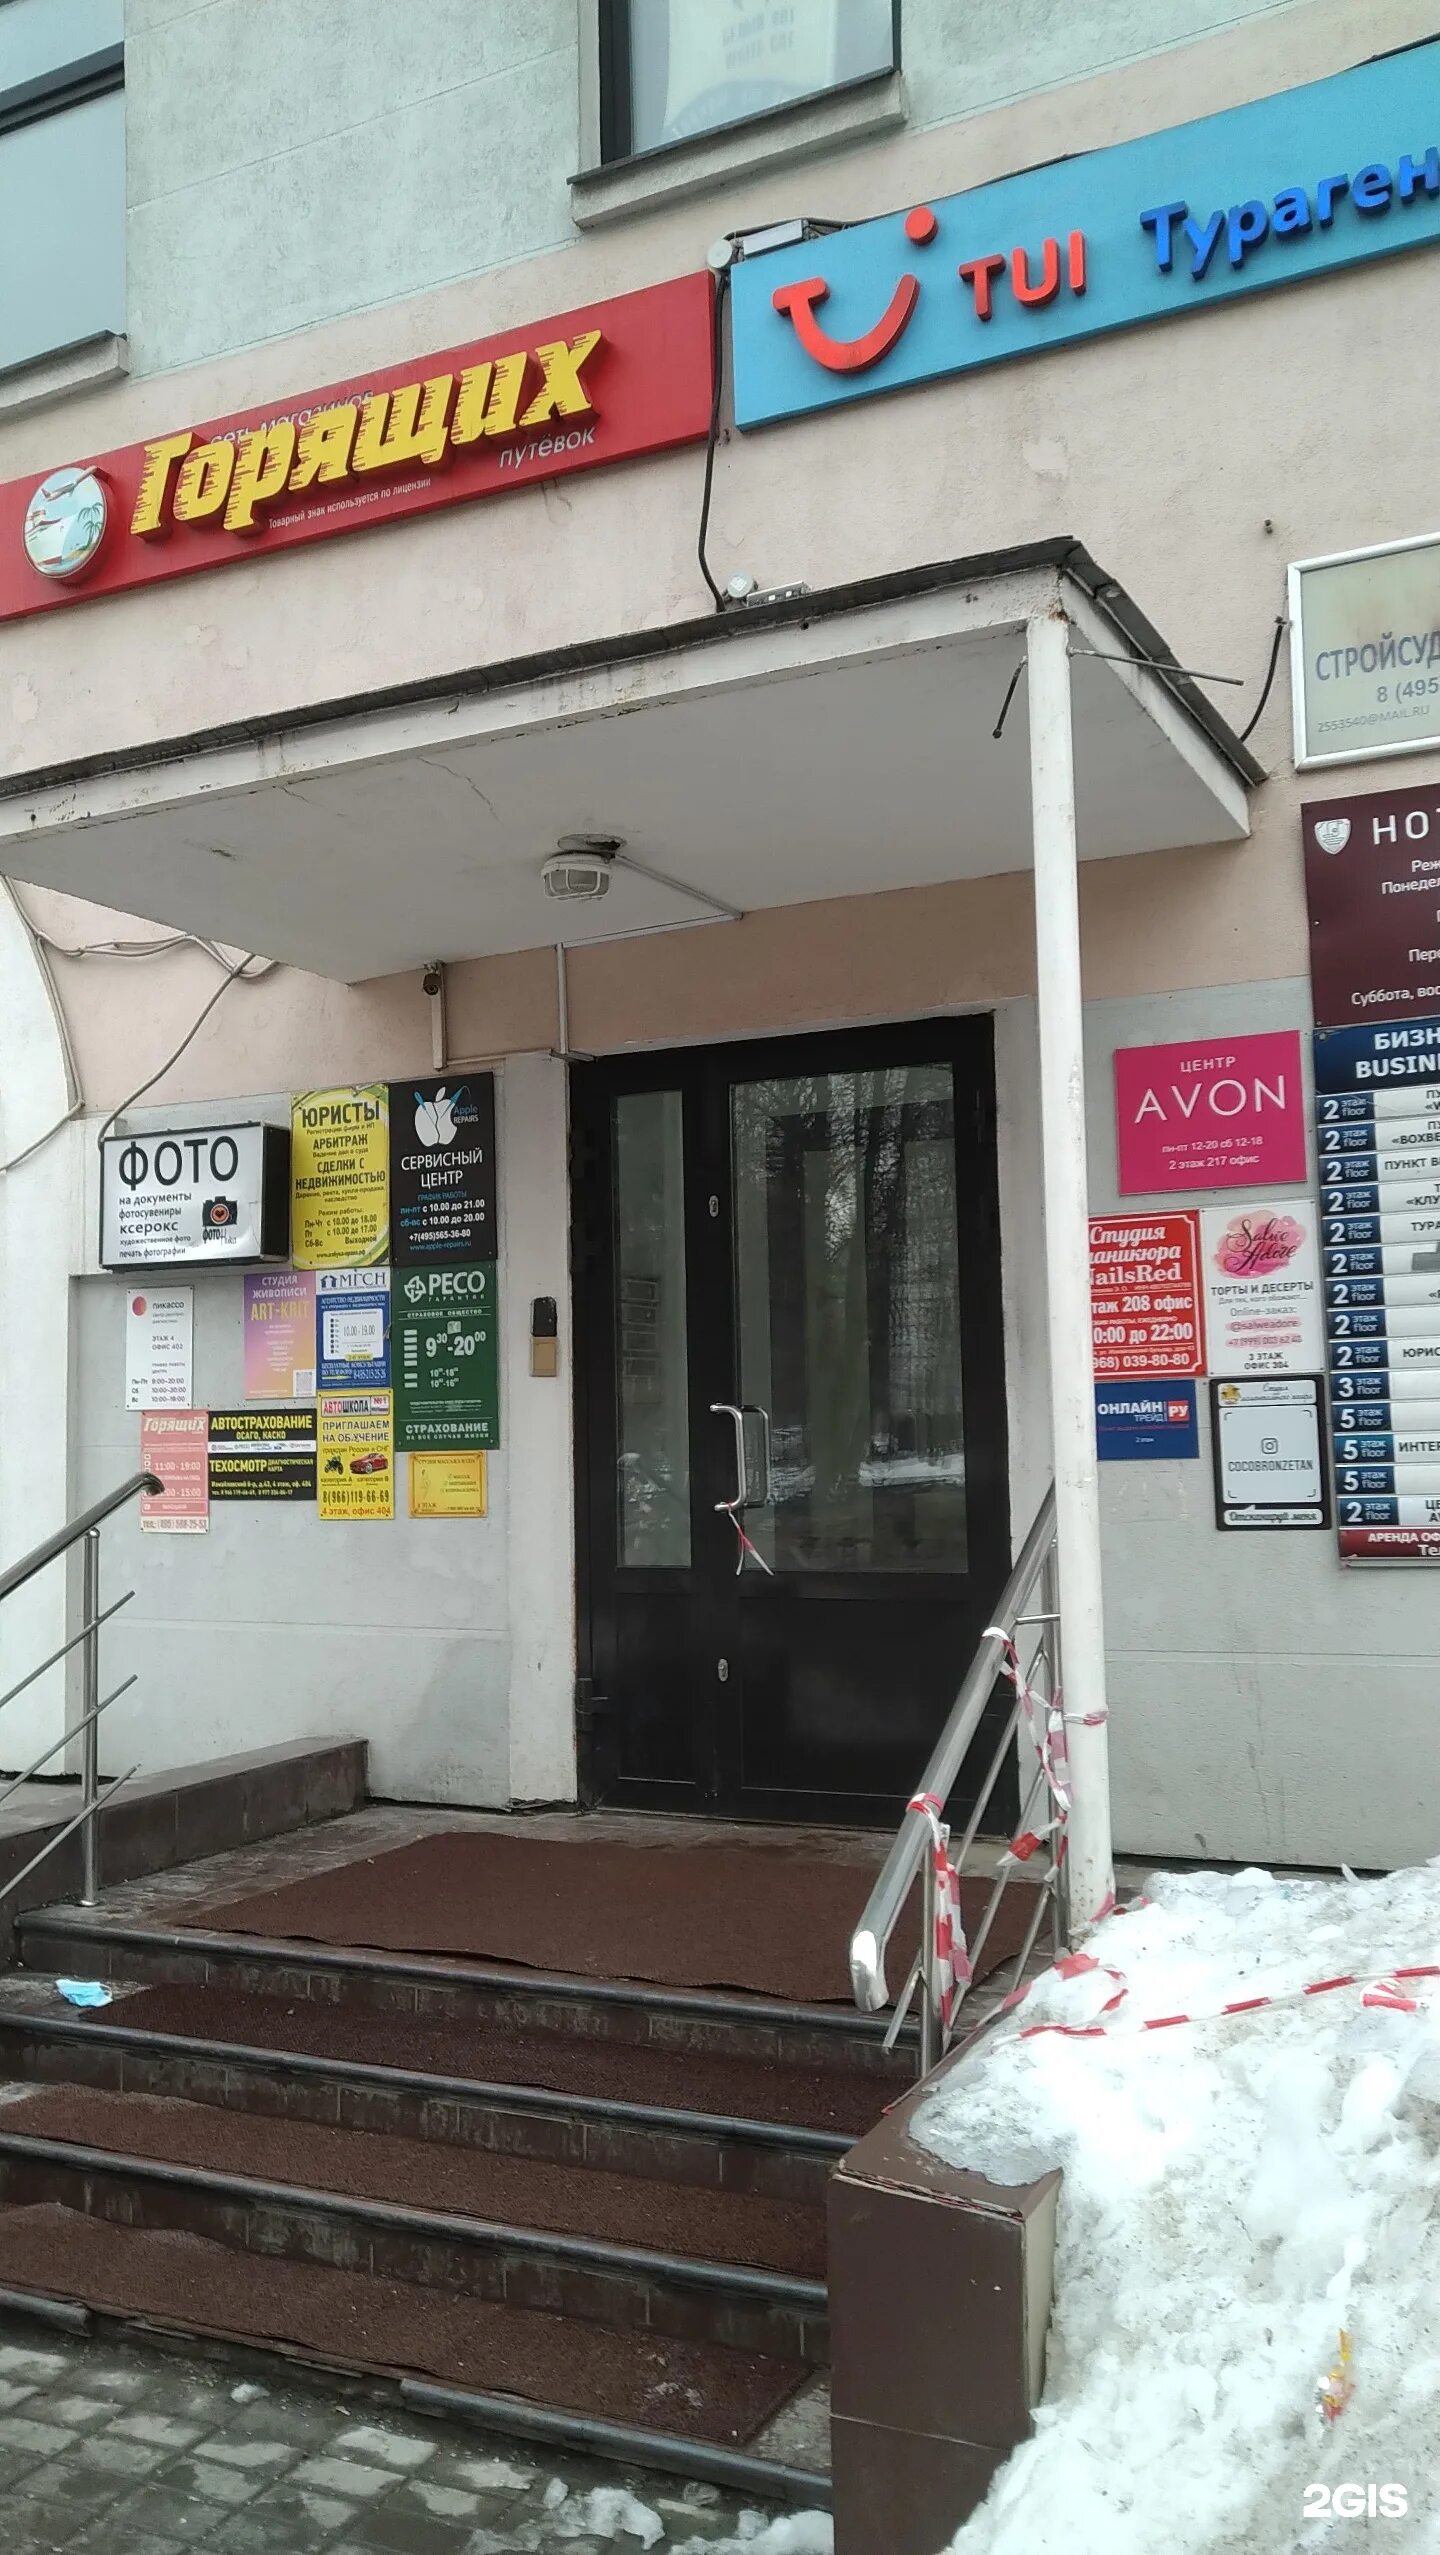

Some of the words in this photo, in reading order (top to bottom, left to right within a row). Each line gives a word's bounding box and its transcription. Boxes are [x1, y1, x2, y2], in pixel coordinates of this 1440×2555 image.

[958, 229, 1087, 322] TUI
[130, 329, 602, 536] Горящих
[500, 427, 595, 469] путёвок
[269, 510, 305, 529] Товарный
[307, 506, 325, 519] знак
[327, 491, 379, 514] используется
[381, 490, 391, 498] по
[392, 478, 431, 496] лицензии
[1377, 686, 1388, 702] 8
[1351, 989, 1414, 1007] Суббота,
[1180, 1056, 1237, 1073] ЦЕНТР
[1356, 1054, 1440, 1078] BUSIN
[1134, 1075, 1286, 1123] AVON
[302, 1101, 379, 1129] ЮРИСТЫ
[454, 1104, 479, 1116] Apple
[1324, 1100, 1339, 1120] 2
[1342, 1099, 1367, 1107] этаж
[1342, 1107, 1366, 1116] floor
[454, 1114, 479, 1124] REPAIRS
[313, 1134, 368, 1150] АРБИТРАЖ
[1162, 1143, 1188, 1152] пн-пт
[1191, 1140, 1218, 1150] 12-20
[1220, 1138, 1233, 1148] сб
[1236, 1136, 1263, 1147] 12-18
[1325, 1131, 1341, 1150] 2
[1343, 1129, 1368, 1137] этаж
[1343, 1138, 1368, 1146] floor
[119, 1136, 239, 1191] ФОТО
[317, 1158, 355, 1174] СДЕЛКИ
[359, 1157, 364, 1169] С
[401, 1147, 483, 1171] СЕРВИСНЫЙ
[1169, 1160, 1176, 1170] 2
[1179, 1160, 1205, 1169] этаж
[1206, 1156, 1227, 1167] 217
[1229, 1155, 1260, 1166] офис
[1385, 1158, 1427, 1170] ПУНКТ
[1327, 1161, 1343, 1181] 2
[1344, 1160, 1370, 1168] этаж
[1345, 1169, 1369, 1177] floor
[295, 1171, 386, 1191] НЕДВИЖИМОСТЬЮ
[421, 1170, 463, 1189] ЦЕНТР
[119, 1197, 131, 1205] на
[133, 1193, 192, 1207] документы
[401, 1205, 421, 1214] пн-пт
[430, 1202, 449, 1212] 10.00
[451, 1202, 462, 1212] до
[464, 1199, 485, 1209] 21.00
[1328, 1191, 1345, 1212] 2
[1346, 1191, 1371, 1199] этаж
[1347, 1199, 1370, 1208] floor
[119, 1208, 182, 1221] фотосувениры
[305, 1220, 323, 1228] Пн-Чт
[333, 1217, 349, 1226] 10.00
[351, 1216, 359, 1224] до
[361, 1214, 377, 1223] 18.00
[429, 1215, 449, 1225] 10.00
[451, 1215, 462, 1224] до
[463, 1212, 485, 1222] 20.00
[120, 1222, 178, 1235] ксерокс
[333, 1227, 350, 1236] 10.00
[351, 1227, 359, 1235] до
[361, 1225, 377, 1233] 17.00
[409, 1229, 471, 1242] +7(495)565-36-80
[1330, 1222, 1346, 1242] 2
[1348, 1222, 1373, 1230] этаж
[1348, 1231, 1372, 1239] floor
[120, 1237, 172, 1247] художественное
[175, 1235, 191, 1244] фото
[305, 1238, 323, 1248] Сб-Вс
[345, 1235, 377, 1245] Выходной
[1089, 1226, 1166, 1248] Студия
[119, 1249, 142, 1258] печать
[143, 1247, 185, 1259] фотографии
[409, 1241, 472, 1251] www.apple-repairs.ru
[1332, 1253, 1348, 1274] 2
[1350, 1253, 1375, 1261] этаж
[1350, 1262, 1374, 1270] floor
[262, 1275, 298, 1287] СТУДИЯ
[429, 1271, 486, 1295] РЕСО
[253, 1288, 307, 1299] ЖИВОПИСИ
[1211, 1284, 1248, 1296] ТОРТЫ
[1251, 1284, 1259, 1293] И
[1262, 1281, 1313, 1294] ДЕСЕРТЫ
[1333, 1284, 1349, 1304] 2
[1122, 1295, 1150, 1312] 208
[1154, 1295, 1193, 1312] офис
[1352, 1292, 1376, 1301] floor
[152, 1301, 185, 1310] пикассо
[1230, 1306, 1297, 1317] Online-заказ:
[407, 1311, 443, 1319] СТРАХОВОЕ
[1230, 1319, 1298, 1332] @salweadore
[1335, 1315, 1351, 1335] 2
[1354, 1323, 1377, 1332] floor
[1094, 1326, 1125, 1344] 0:00
[1129, 1329, 1147, 1345] до
[1151, 1323, 1193, 1340] 22:00
[1123, 1353, 1189, 1368] 039-80-80
[1257, 1352, 1283, 1361] ЭТАЖ
[1337, 1346, 1353, 1366] 2
[1355, 1346, 1380, 1354] этаж
[1356, 1355, 1380, 1363] floor
[1244, 1361, 1270, 1370] ОФИС
[1338, 1377, 1354, 1397] 3
[1357, 1386, 1381, 1394] floor
[324, 1400, 369, 1414] АВТОШКОЛА
[1097, 1400, 1163, 1415] ОНЛАЙН
[1168, 1405, 1189, 1417] РУ
[211, 1415, 313, 1430] АВТОСТРАХОВАНИЕ
[1134, 1413, 1163, 1422] ТРЕЙД
[1340, 1409, 1355, 1429] 5
[1359, 1417, 1383, 1426] floor
[144, 1417, 205, 1435] Горящих
[323, 1420, 390, 1430] ПРИГЛАШАЕМ
[406, 1423, 489, 1434] СТРАХОВАНИЕ
[236, 1431, 260, 1440] ОСАГО,
[263, 1431, 286, 1439] КАСКО
[323, 1434, 335, 1442] НА
[338, 1432, 389, 1442] ОБУЧЕНИЕ
[1343, 1439, 1358, 1460] 5
[1360, 1440, 1386, 1448] этаж
[1362, 1449, 1386, 1457] floor
[209, 1460, 267, 1472] ТЕХОСМОТР
[1228, 1460, 1313, 1472] COCOBRONZETAN
[1344, 1471, 1359, 1491] 5
[1361, 1471, 1387, 1479] этаж
[1362, 1480, 1387, 1488] floor
[323, 1490, 389, 1505] 8(966)119-66-69
[352, 1507, 375, 1515] офис
[1346, 1502, 1363, 1522] 2
[1365, 1503, 1390, 1511] этаж
[1366, 1512, 1391, 1520] floor
[1368, 1532, 1419, 1543] АРЕНДА
